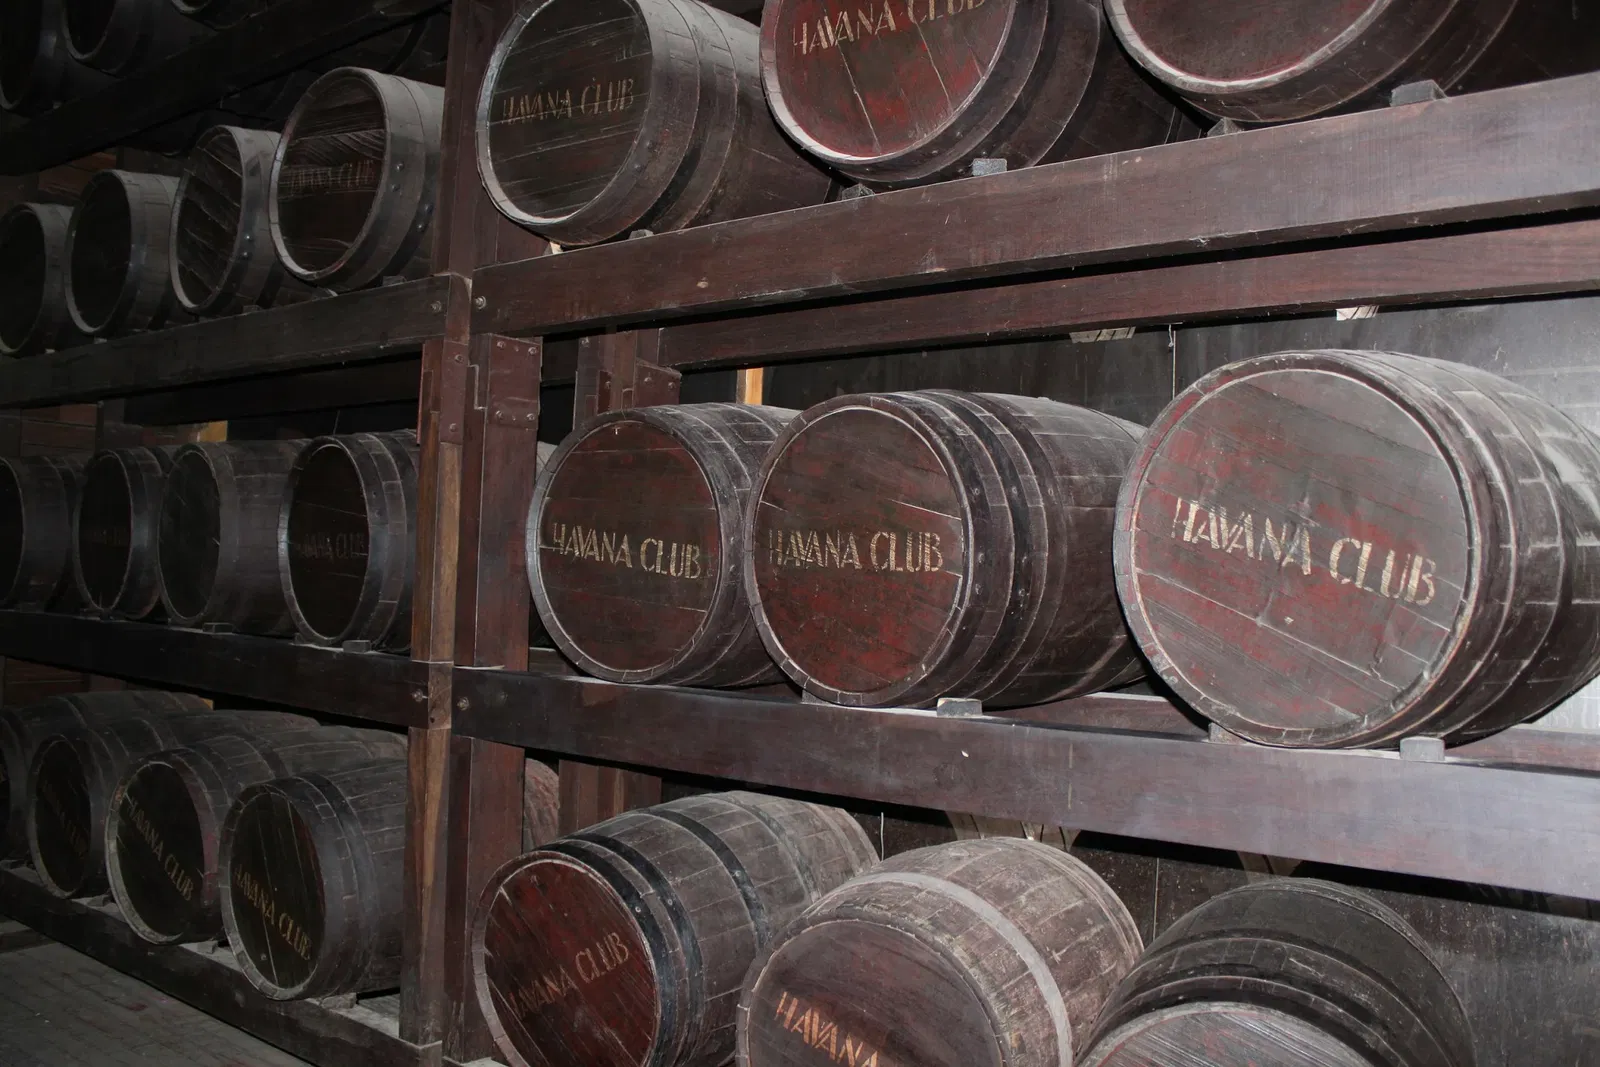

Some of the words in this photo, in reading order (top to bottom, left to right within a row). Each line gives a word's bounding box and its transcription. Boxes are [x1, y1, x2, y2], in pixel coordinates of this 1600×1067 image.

[793, 0, 897, 56] HAVANA
[502, 88, 573, 125] HAVANA
[580, 78, 634, 115] CLUB
[552, 521, 634, 569] HAVANA
[639, 537, 702, 579] CLUB
[769, 529, 864, 571] HAVANA
[869, 530, 944, 573] CLUB
[1171, 497, 1312, 576] HAVANA
[1329, 537, 1436, 606] CLUB
[127, 796, 164, 863] HAVANA
[164, 853, 195, 902] CLUB
[279, 912, 313, 962] CLUB
[575, 931, 629, 984] CLUB
